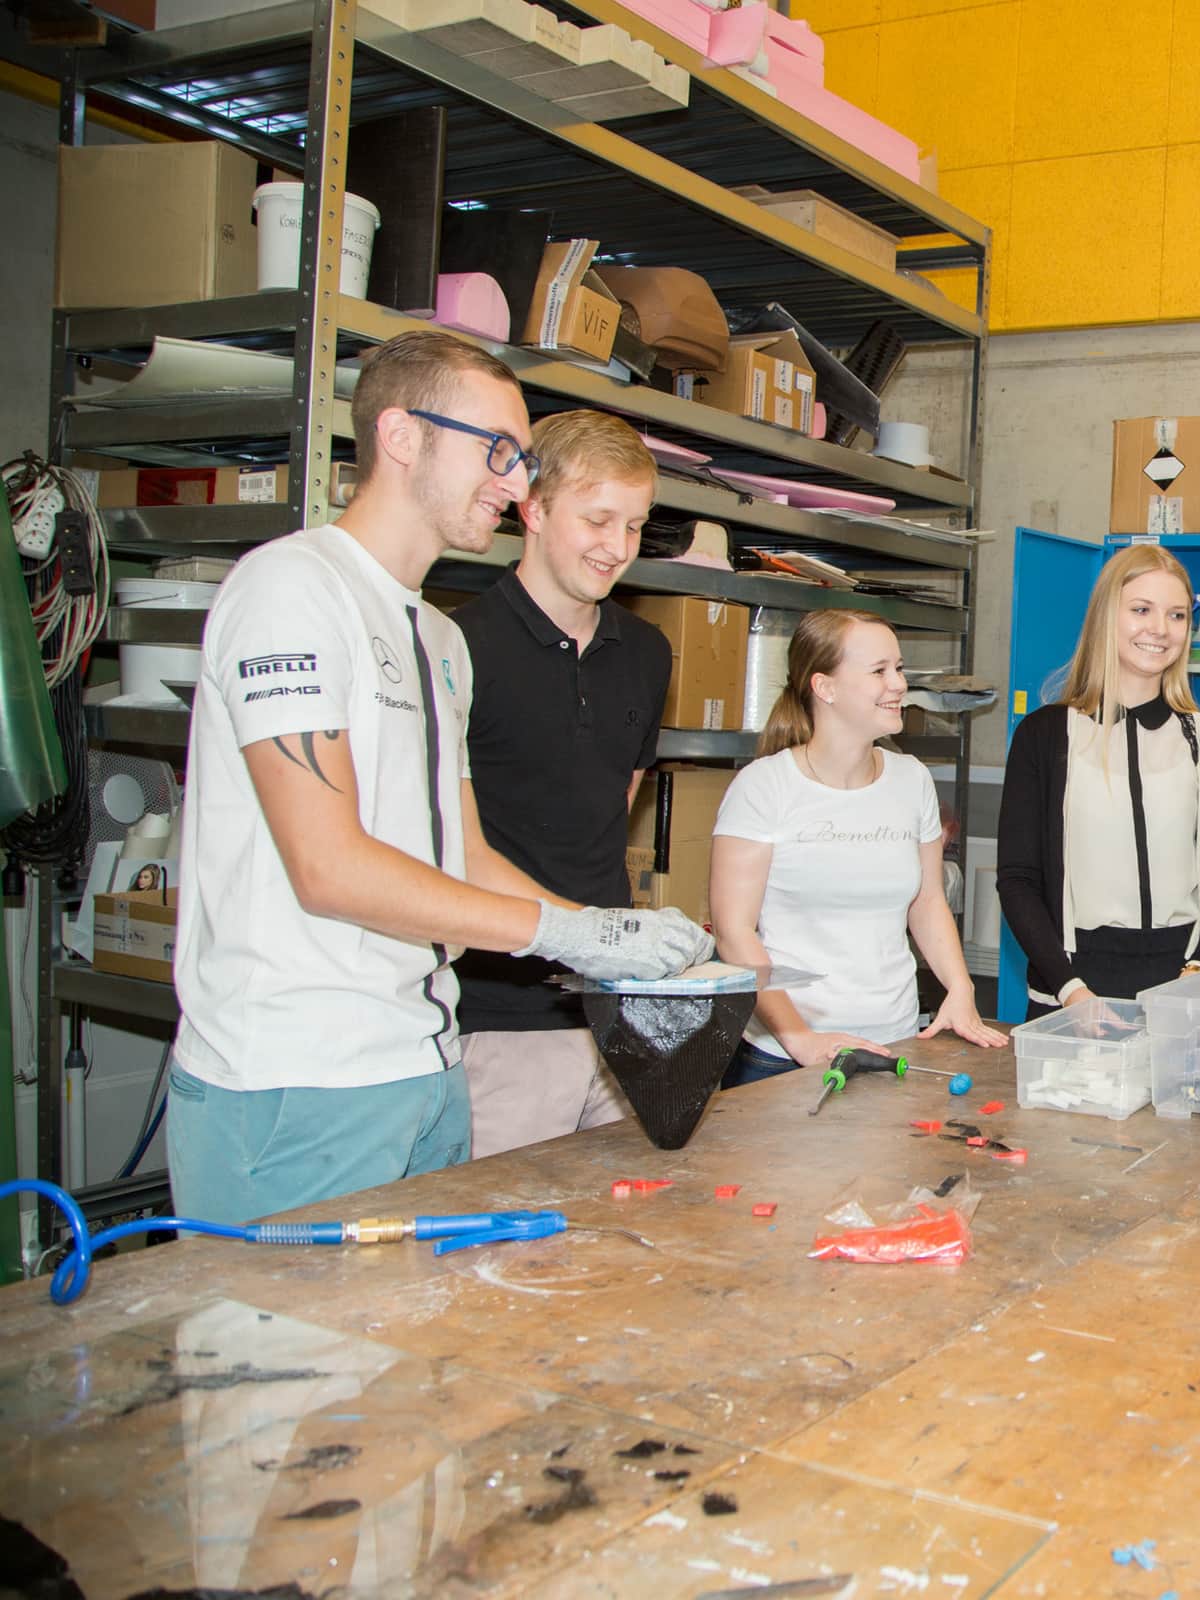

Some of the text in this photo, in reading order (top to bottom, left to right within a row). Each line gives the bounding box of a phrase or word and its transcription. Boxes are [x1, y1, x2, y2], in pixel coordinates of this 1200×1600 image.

[239, 653, 317, 679] PIRELLI
[269, 685, 321, 697] AMG
[797, 820, 914, 842] Benetton
